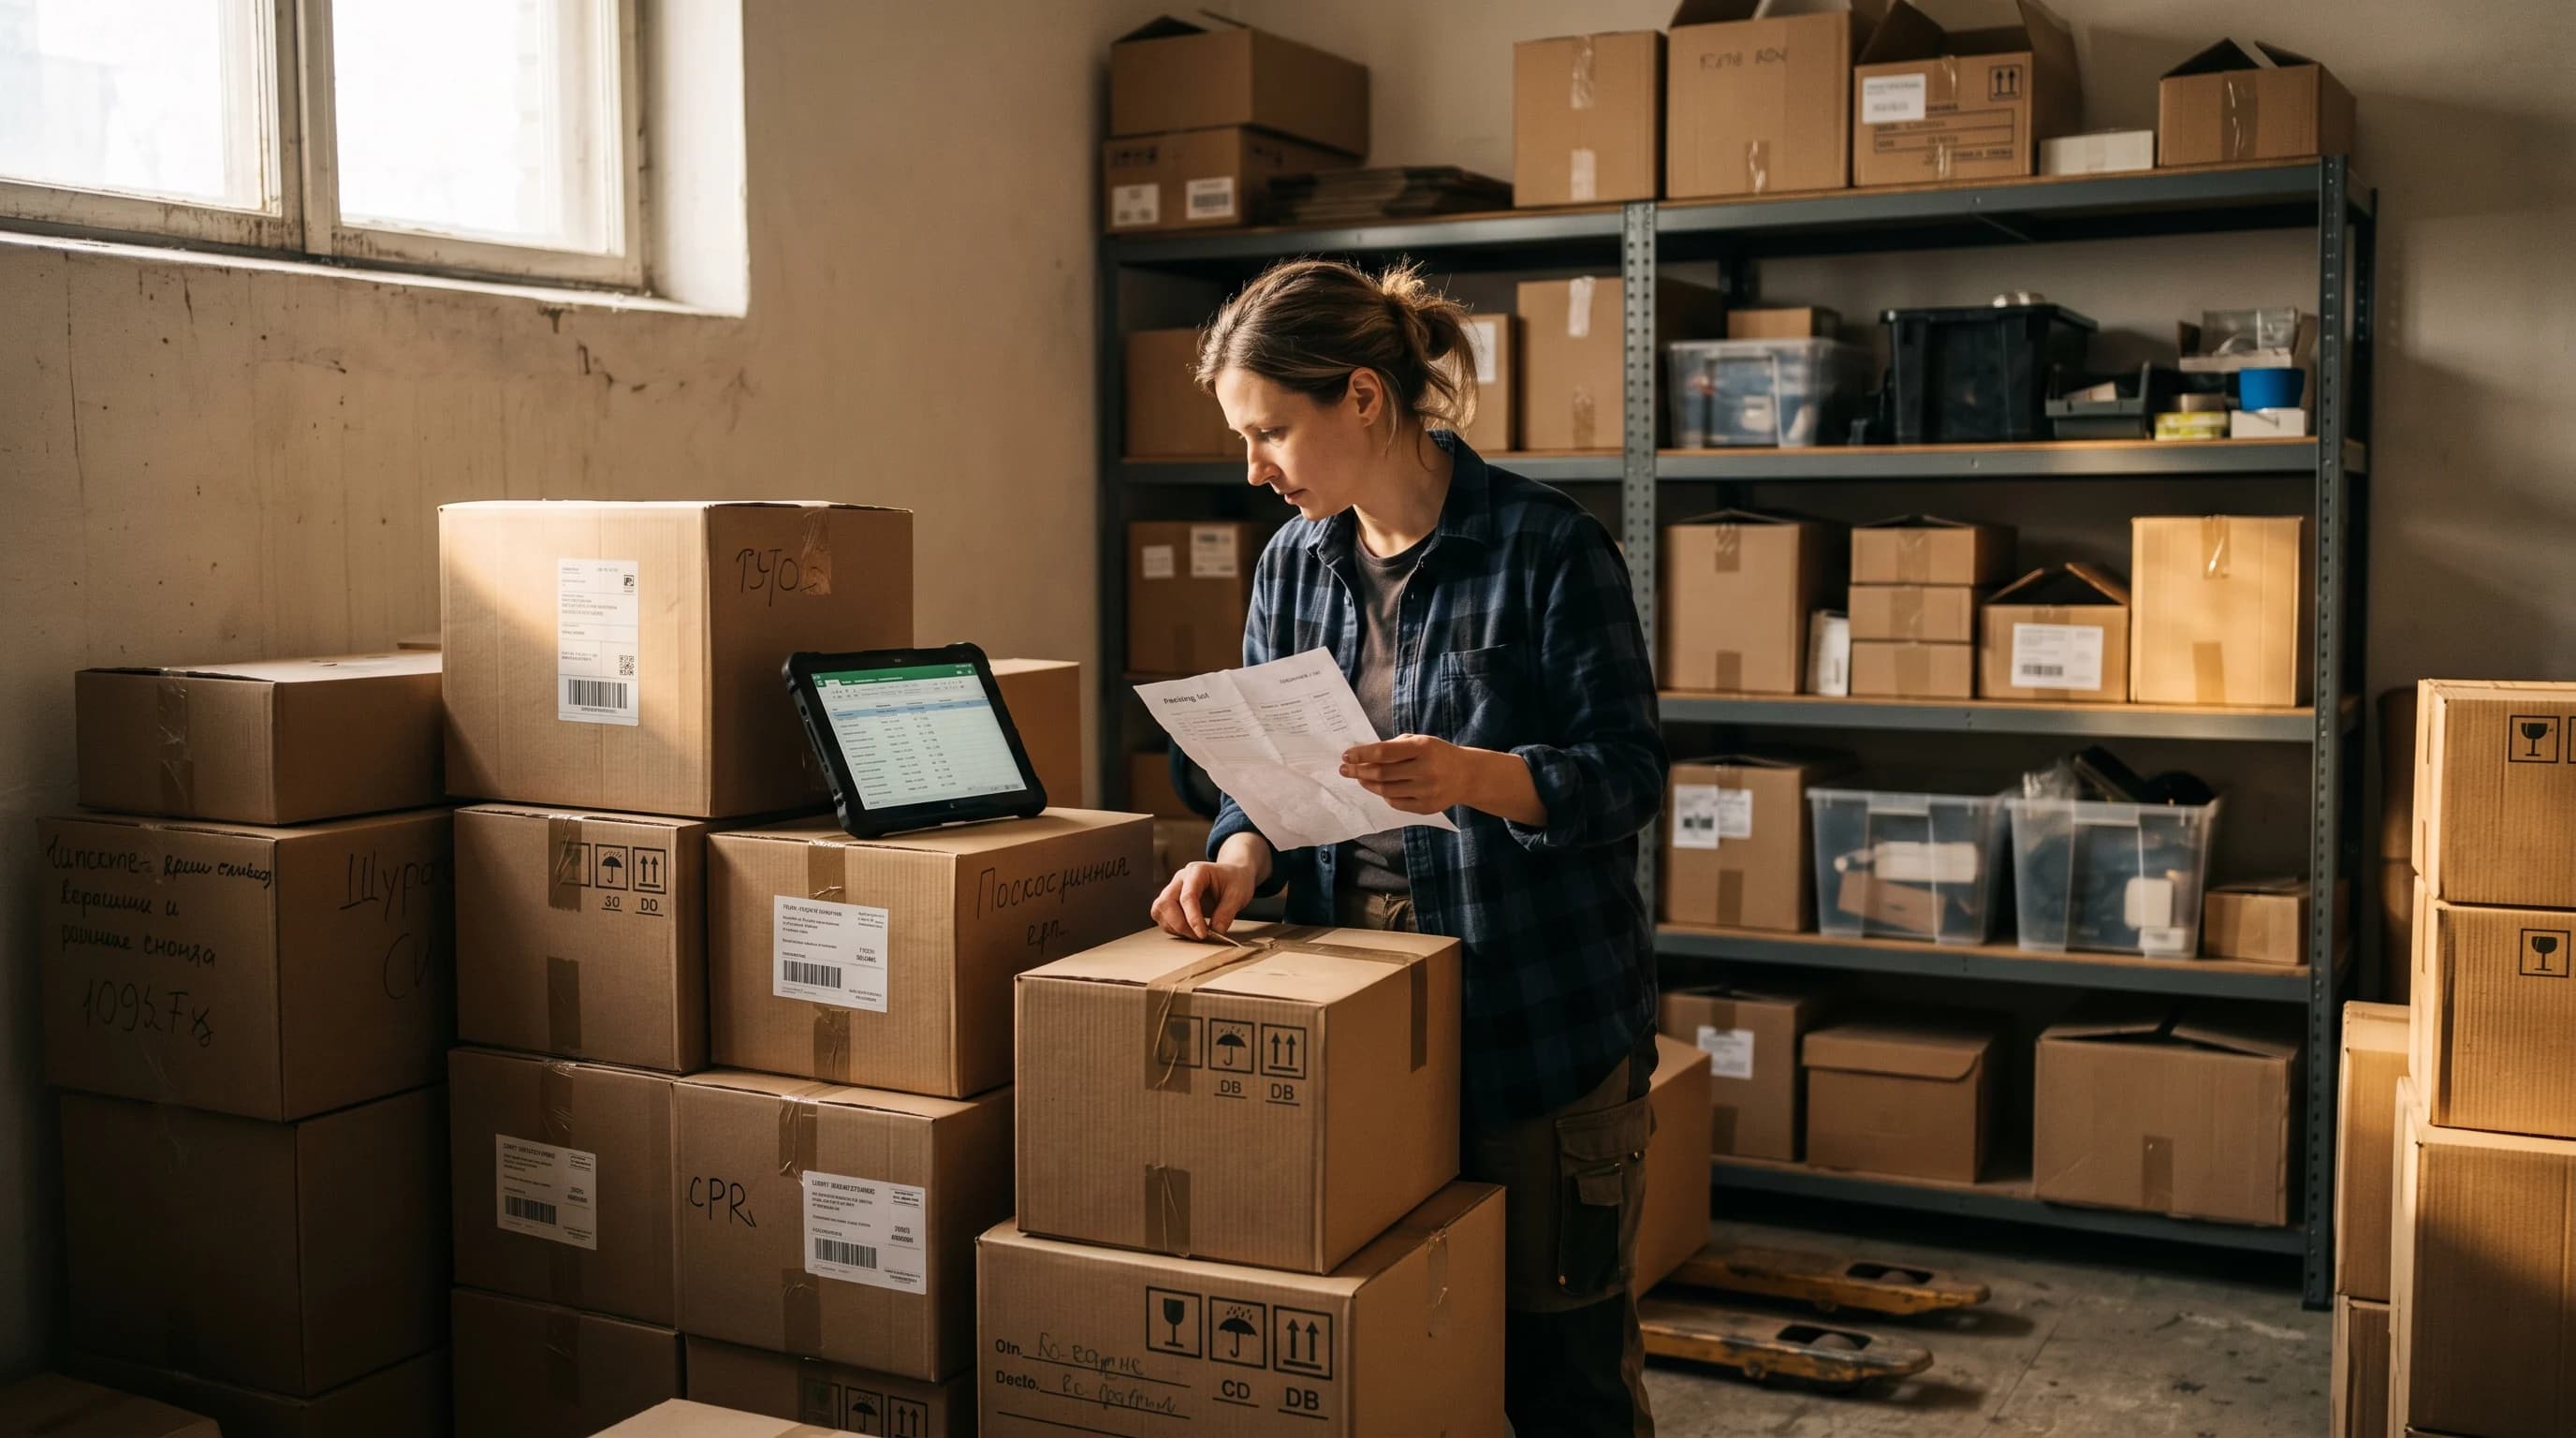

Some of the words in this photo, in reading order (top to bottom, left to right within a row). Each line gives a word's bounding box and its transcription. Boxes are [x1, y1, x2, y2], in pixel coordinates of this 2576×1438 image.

[640, 897, 658, 912] DO
[1220, 1079, 1242, 1094] DB
[1270, 1083, 1295, 1101] DB
[1221, 1379, 1251, 1401] CD
[1285, 1387, 1321, 1411] DB
